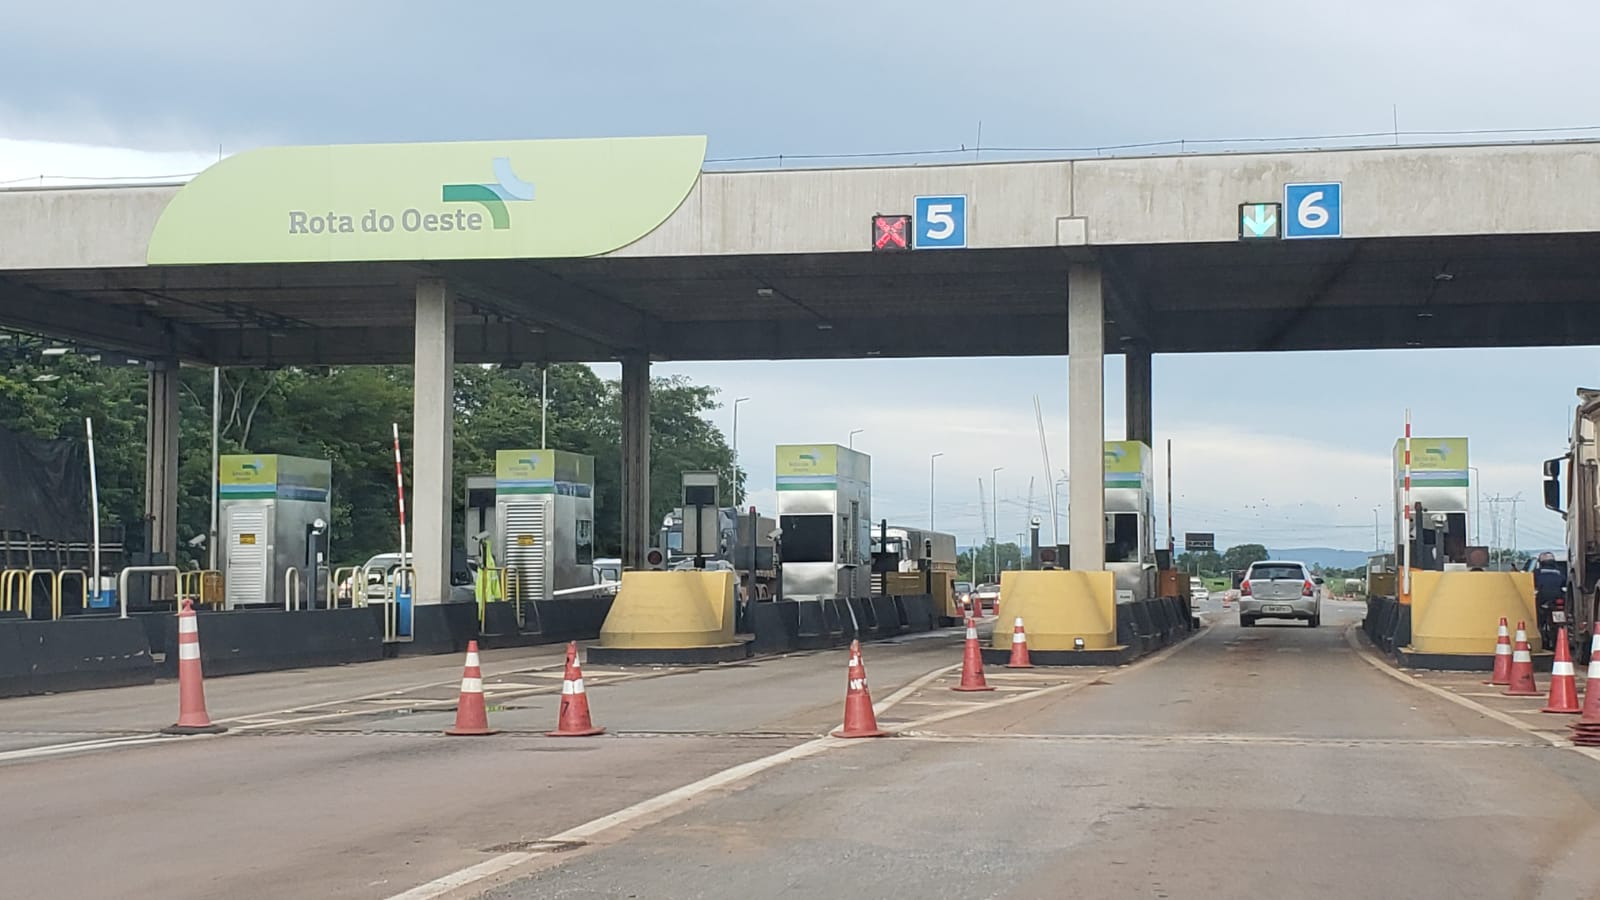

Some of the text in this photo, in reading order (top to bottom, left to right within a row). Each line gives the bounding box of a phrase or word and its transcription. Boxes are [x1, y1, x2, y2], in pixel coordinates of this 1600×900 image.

[289, 209, 482, 234] Rota do Oeste
[926, 204, 955, 240] 5
[1298, 191, 1329, 228] 6
